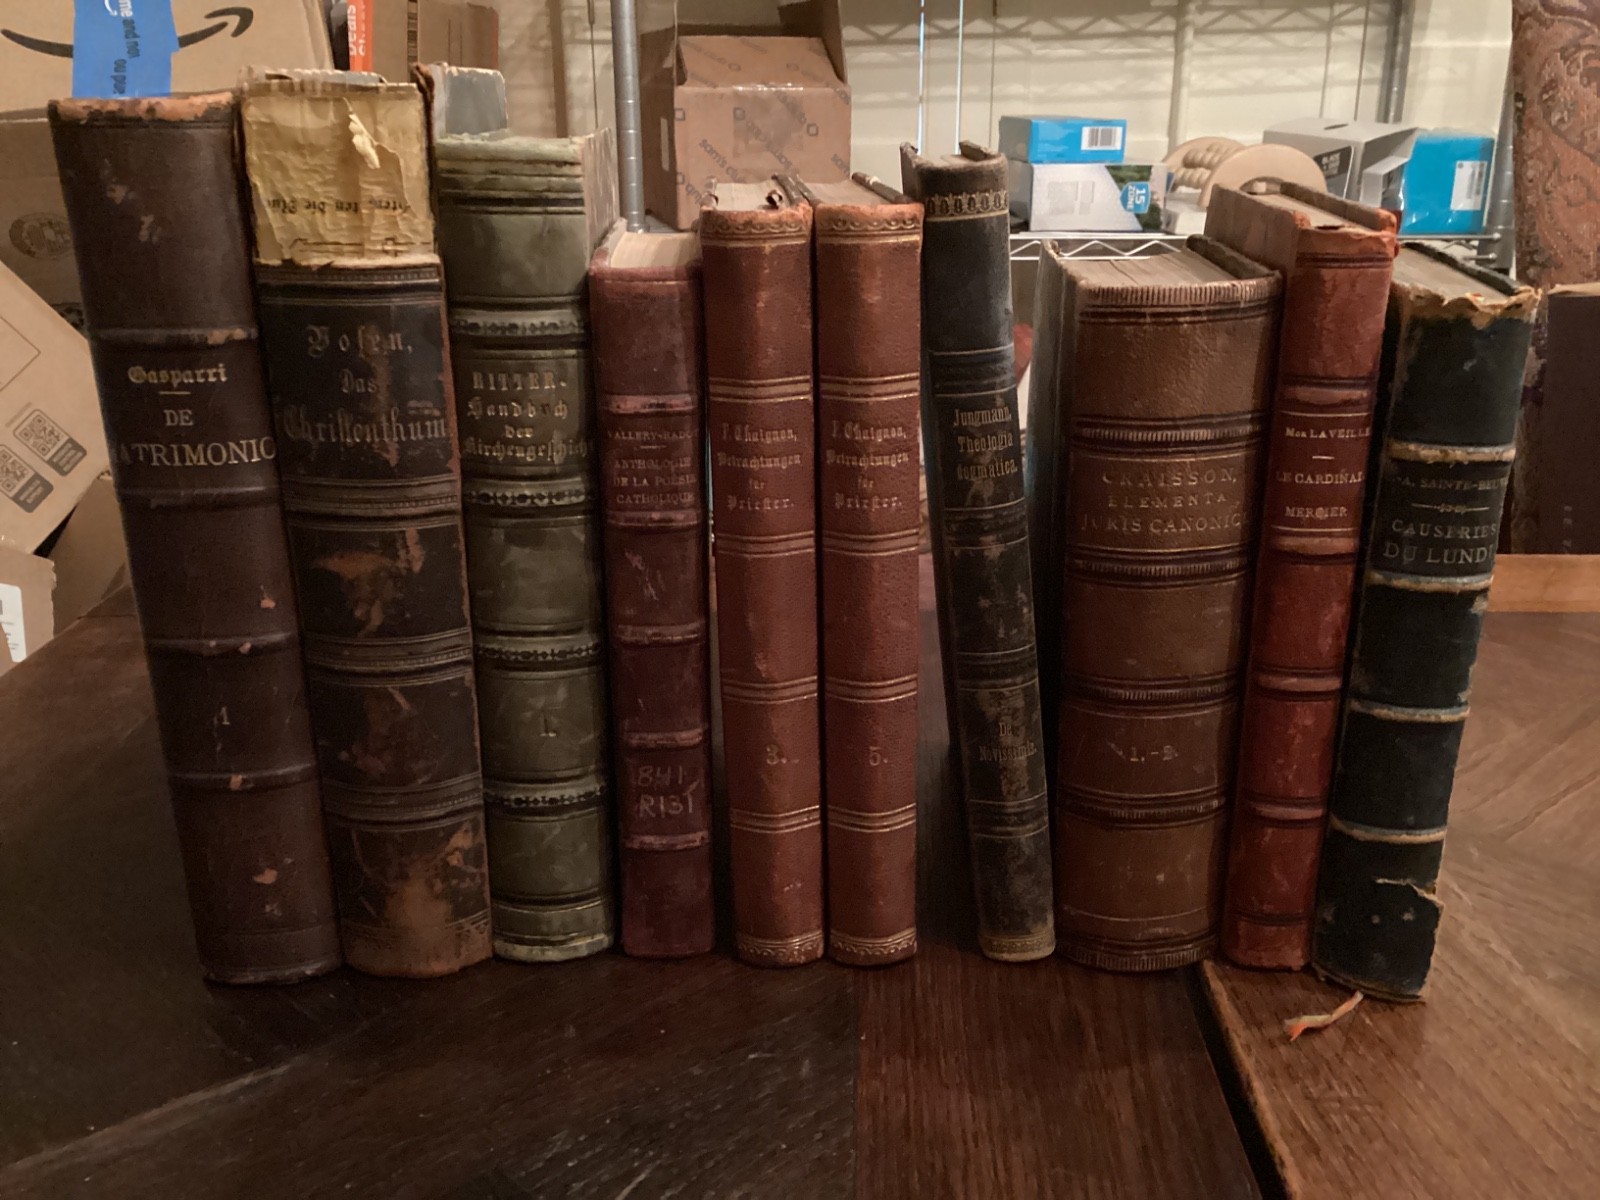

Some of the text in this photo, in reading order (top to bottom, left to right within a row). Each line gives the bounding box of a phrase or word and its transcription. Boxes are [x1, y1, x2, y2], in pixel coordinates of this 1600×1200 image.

[1127, 185, 1135, 210] ZONE
[1135, 188, 1146, 204] 15
[127, 363, 228, 388] Gasparri
[164, 409, 194, 426] DE
[957, 431, 1014, 452] Theologia
[633, 476, 649, 487] LA
[1294, 470, 1365, 484] CARDINAL
[1108, 492, 1227, 508] ELEMENTA
[1284, 506, 1348, 519] MERCIER
[1391, 519, 1498, 539] CAUSERIES
[1382, 541, 1418, 562] DU
